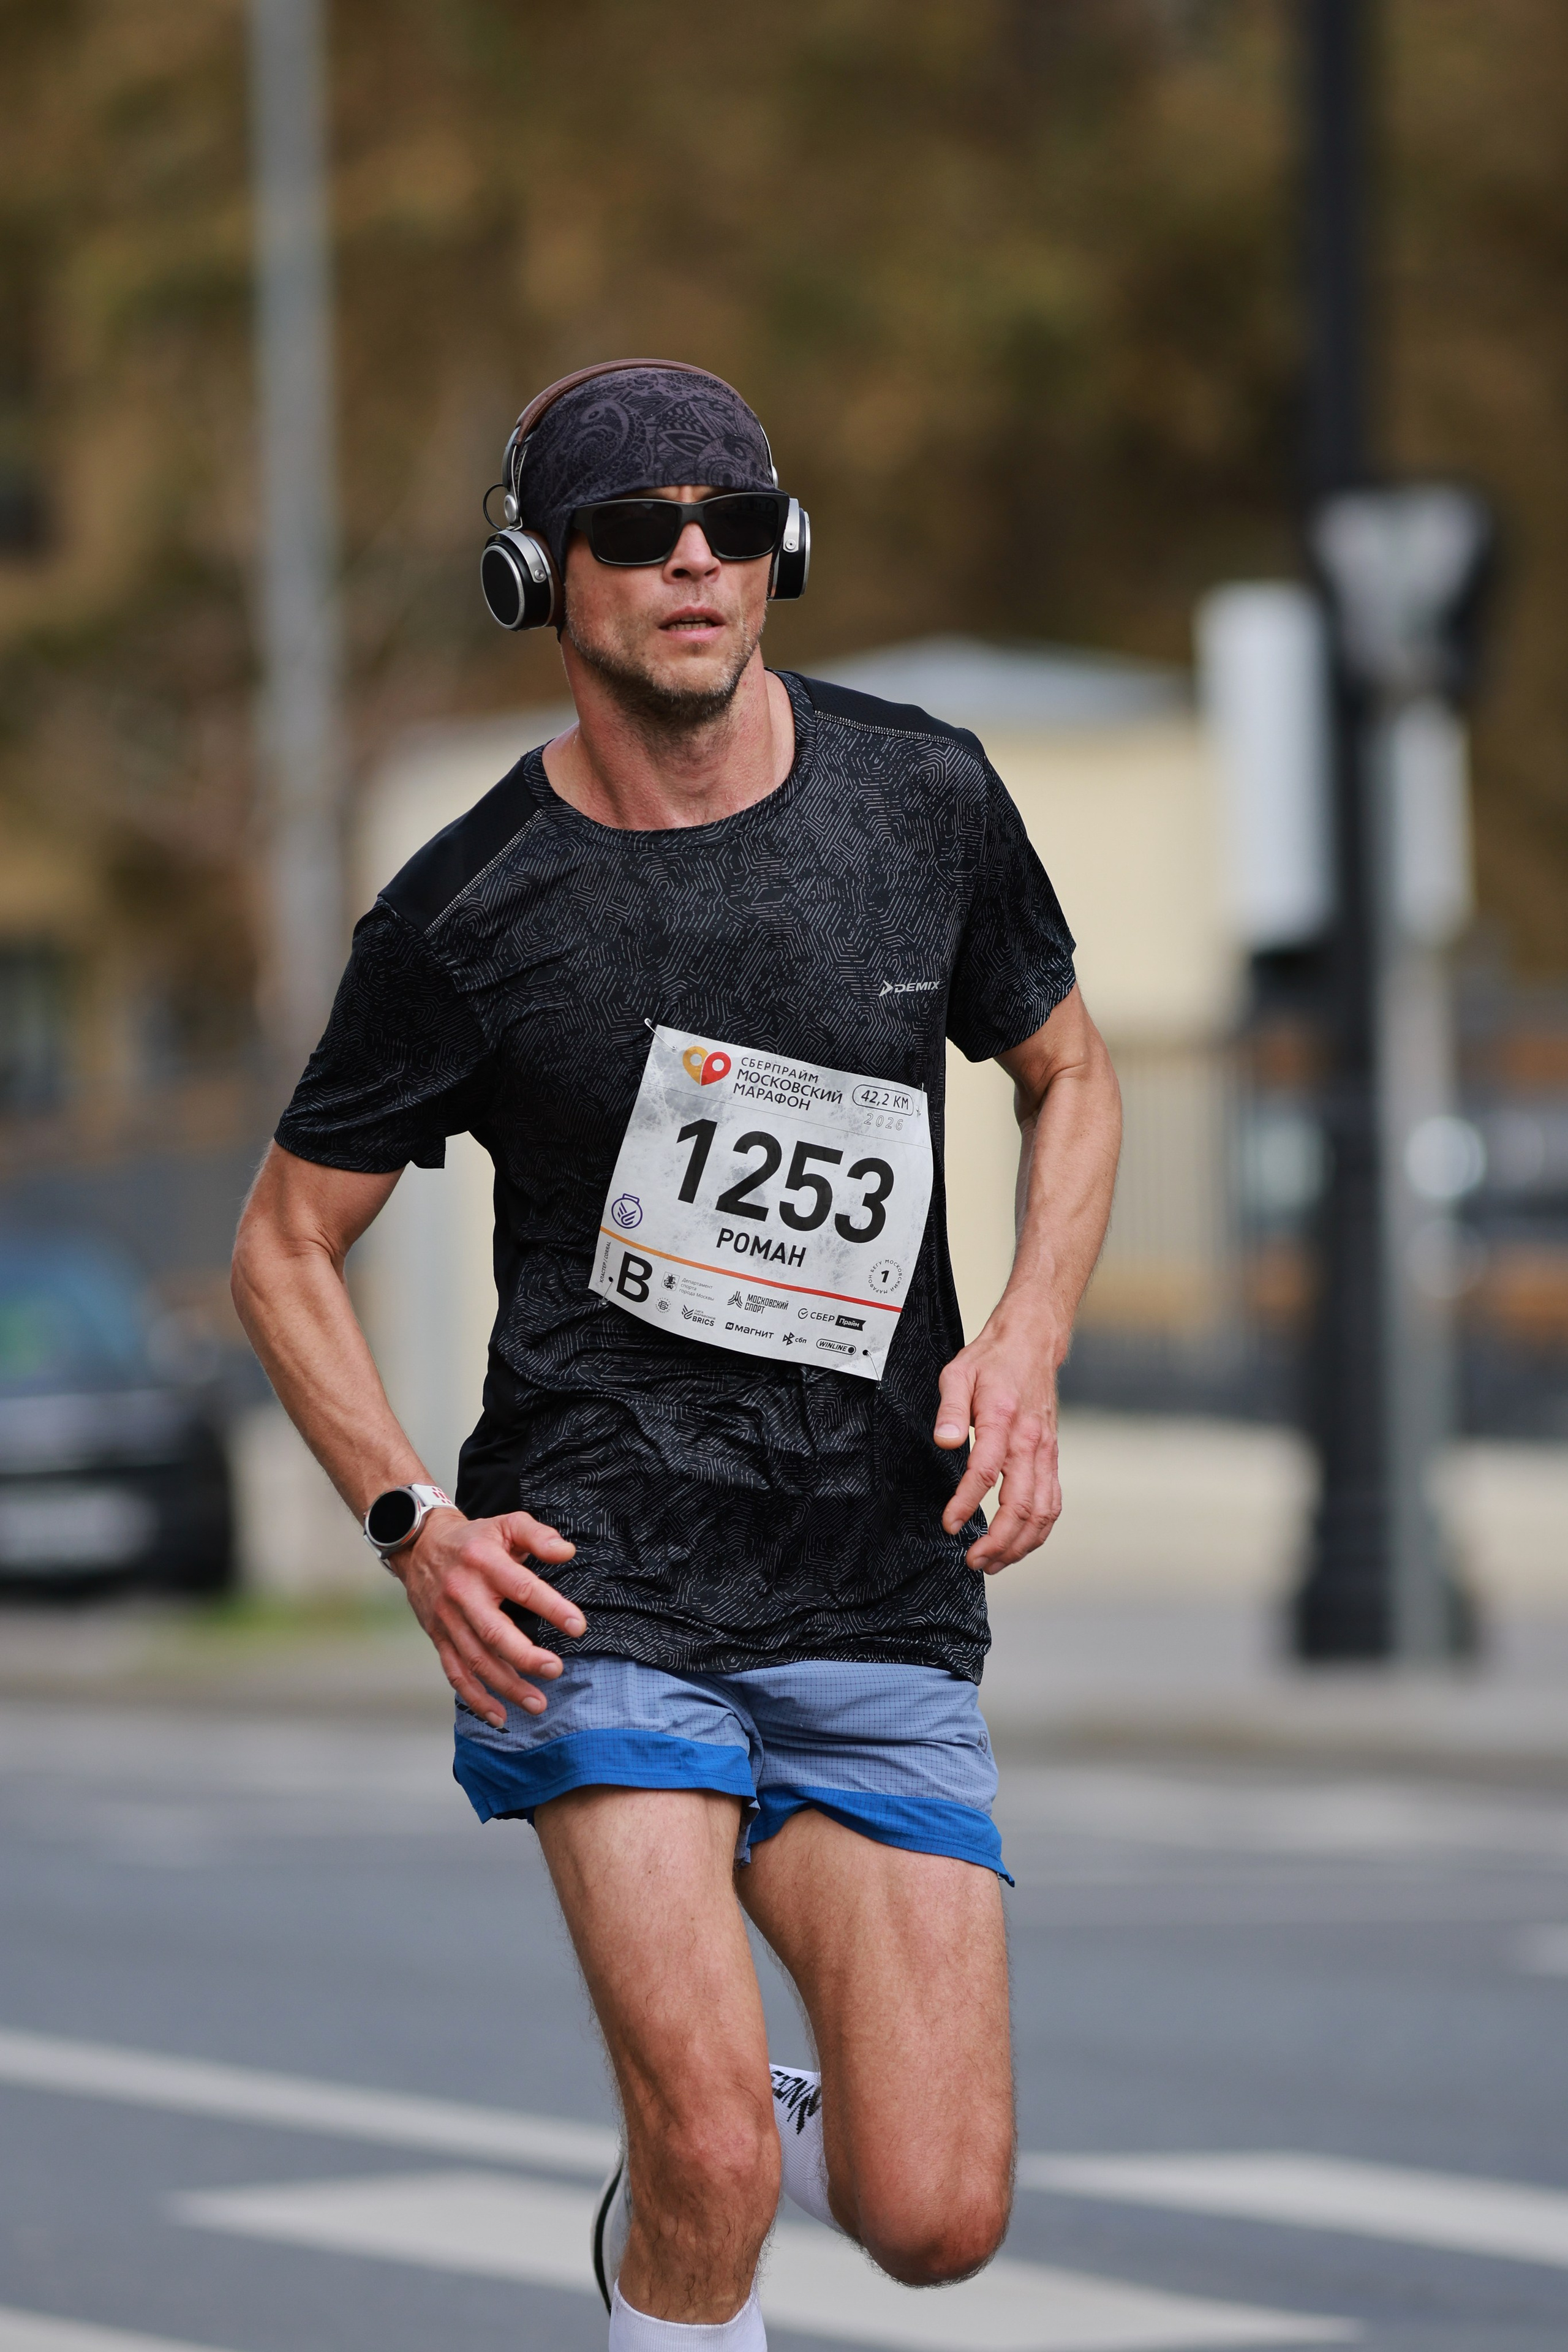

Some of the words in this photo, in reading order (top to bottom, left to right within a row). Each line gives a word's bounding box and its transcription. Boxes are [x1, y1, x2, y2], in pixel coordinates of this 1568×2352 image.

[895, 981, 940, 993] DEMIX
[741, 1057, 818, 1083] СБЕРПРАЙМ
[737, 1069, 842, 1104] МОСКОВСКИЙ
[733, 1083, 811, 1110] МАРАФОН
[861, 1090, 889, 1106] 42,2
[864, 1113, 903, 1131] 2026
[676, 1118, 894, 1243] 1253
[716, 1228, 807, 1267] РОМАН
[870, 1261, 882, 1273] БЕГУ
[682, 1278, 713, 1289] Департамент
[881, 1270, 889, 1283] 1
[885, 1259, 902, 1292] МОСКОВСКИЙ
[868, 1275, 888, 1294] МАРАФОН
[696, 1292, 715, 1301] Москвы
[747, 1294, 789, 1311] МОСКОВСКИЙ
[744, 1302, 766, 1314] СПОРТ
[692, 1315, 715, 1327] BRICS
[810, 1312, 835, 1322] СБЕР
[839, 1318, 860, 1327] Прайм
[819, 1340, 847, 1352] WINLINE
